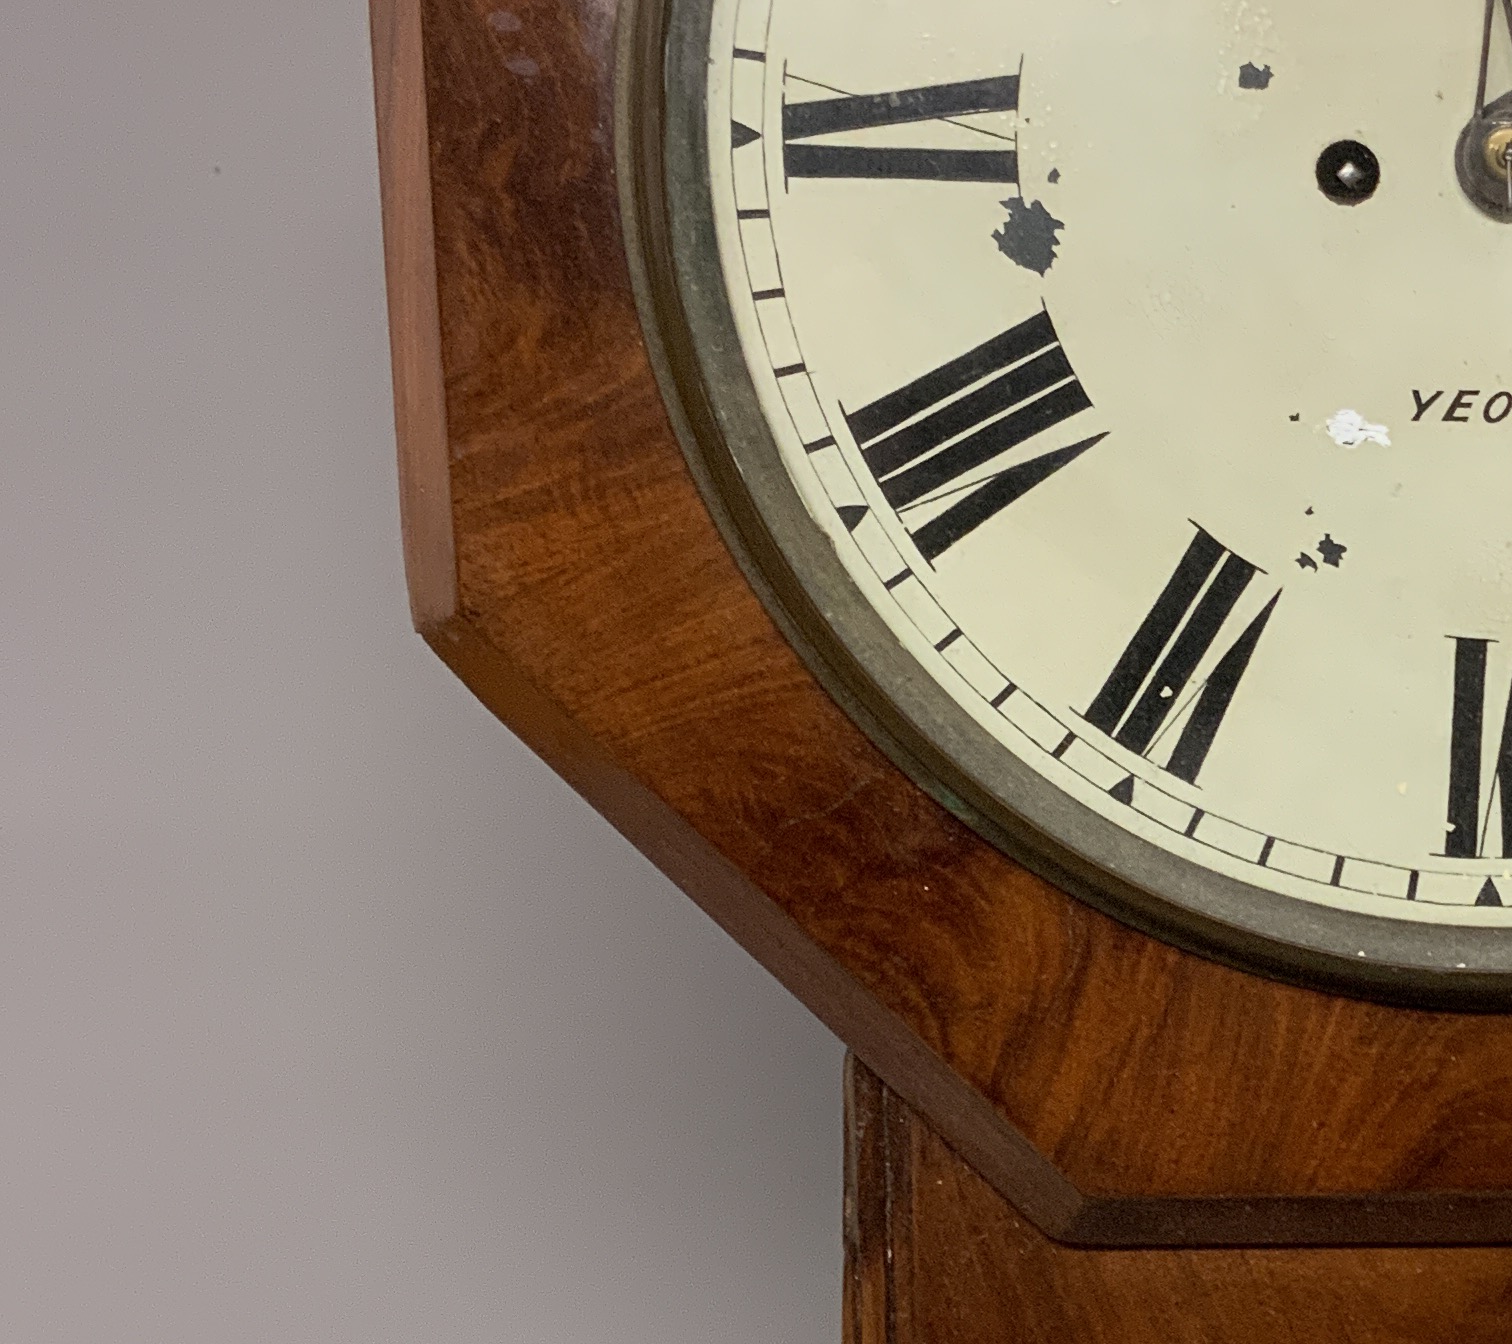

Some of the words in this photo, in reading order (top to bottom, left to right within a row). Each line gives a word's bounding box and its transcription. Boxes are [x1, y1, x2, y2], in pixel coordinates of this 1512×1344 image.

[783, 52, 1024, 194] IX
[838, 297, 1111, 573] VIII
[1069, 518, 1283, 790] VII
